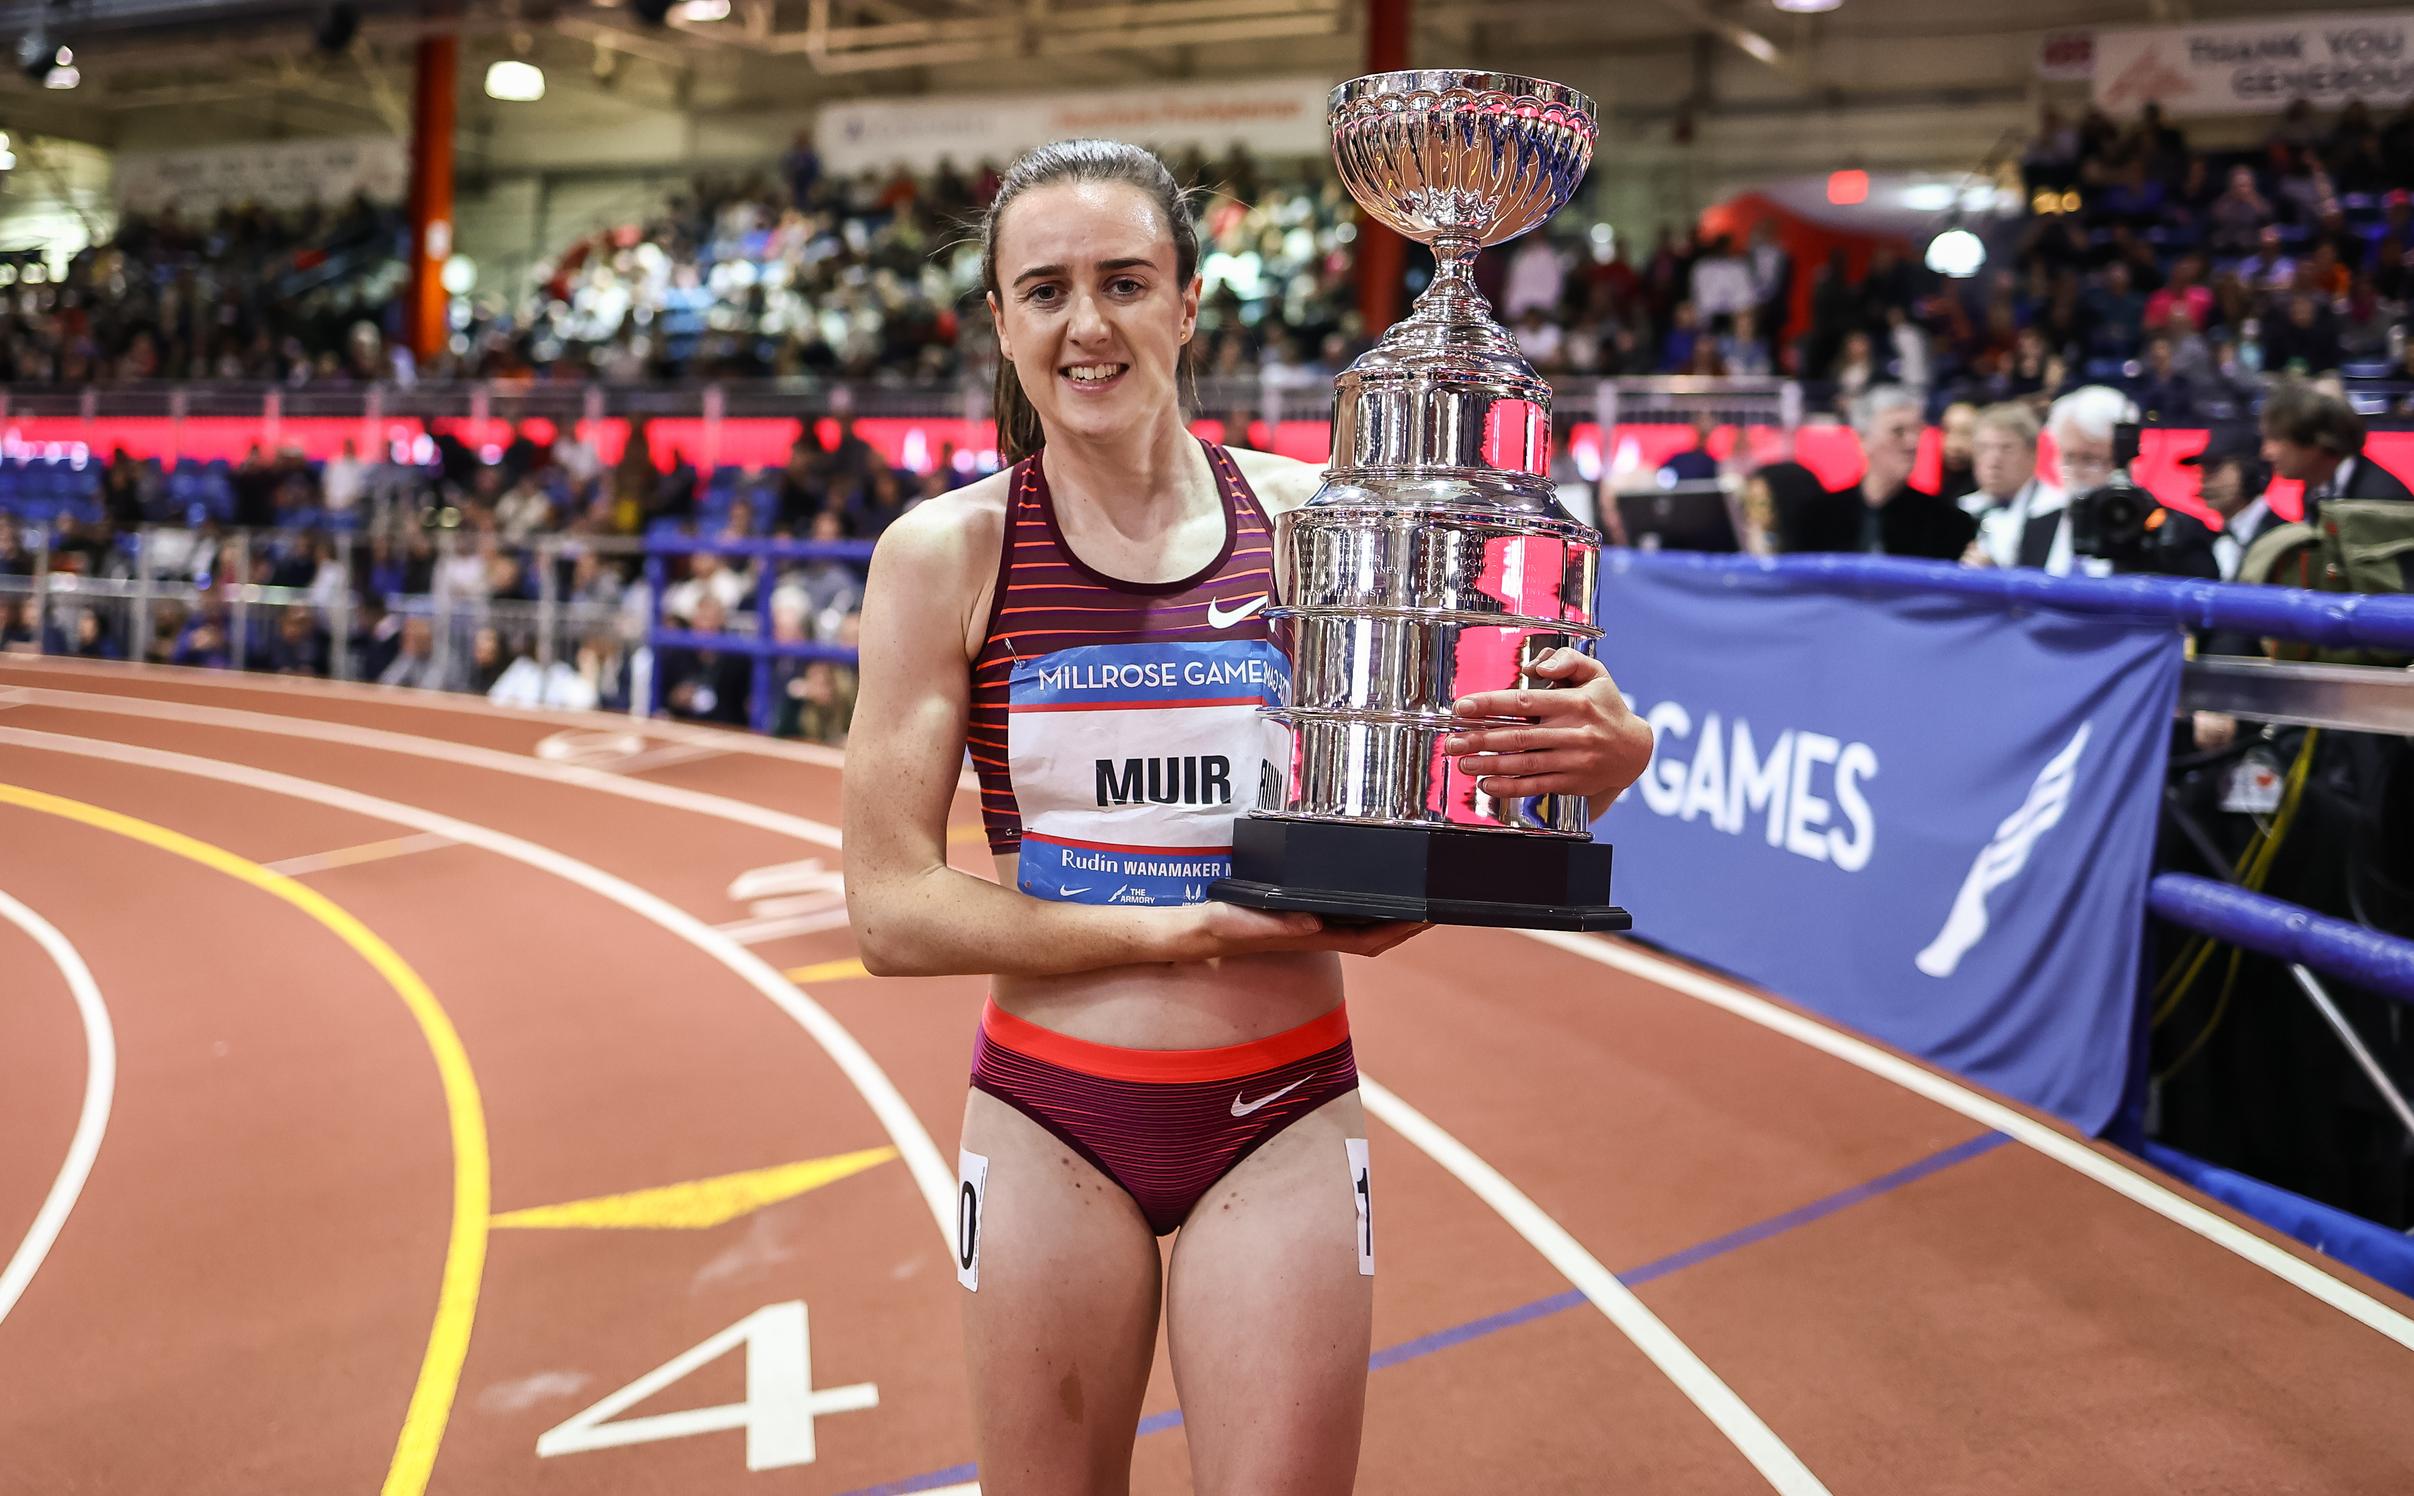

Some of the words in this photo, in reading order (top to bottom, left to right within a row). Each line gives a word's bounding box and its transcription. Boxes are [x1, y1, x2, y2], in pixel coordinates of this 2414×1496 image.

[2188, 34, 2303, 65] THANK
[2325, 28, 2405, 60] YOU
[1038, 662, 1178, 691] MILLROSE
[1184, 659, 1265, 687] GAME
[1095, 755, 1232, 806] MUIR
[1638, 700, 1879, 873] GAMES
[1123, 861, 1221, 877] WANAMAKER
[1120, 895, 1155, 904] ARMORY
[1130, 888, 1146, 897] THE
[535, 1299, 880, 1472] 4
